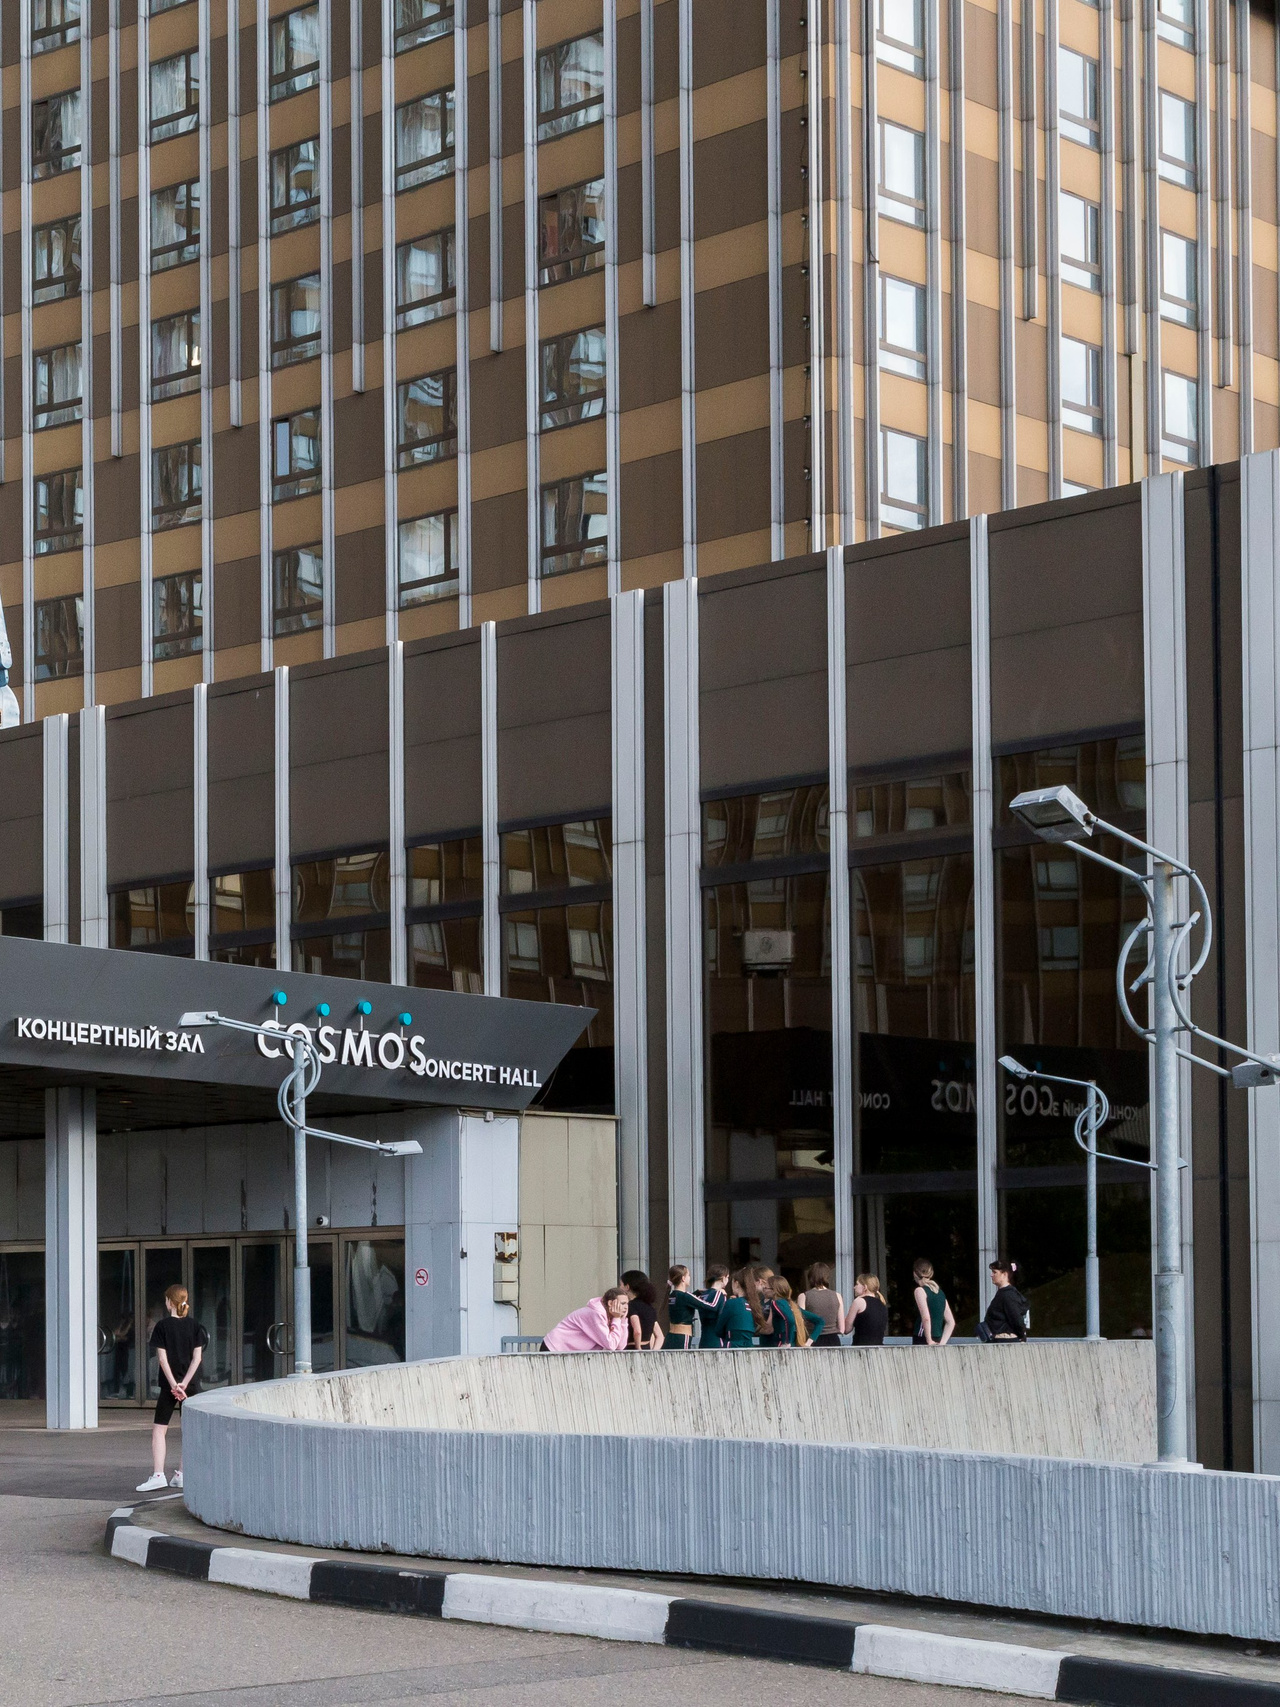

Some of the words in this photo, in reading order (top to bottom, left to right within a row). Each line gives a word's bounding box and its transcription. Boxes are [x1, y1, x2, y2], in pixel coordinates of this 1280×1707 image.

[17, 1017, 161, 1050] КОНЦЕРТНЫЙ
[165, 1031, 206, 1054] ЗАЛ
[256, 1019, 426, 1073] COSMOS
[416, 1058, 494, 1083] ONCERT
[499, 1066, 543, 1088] HALL
